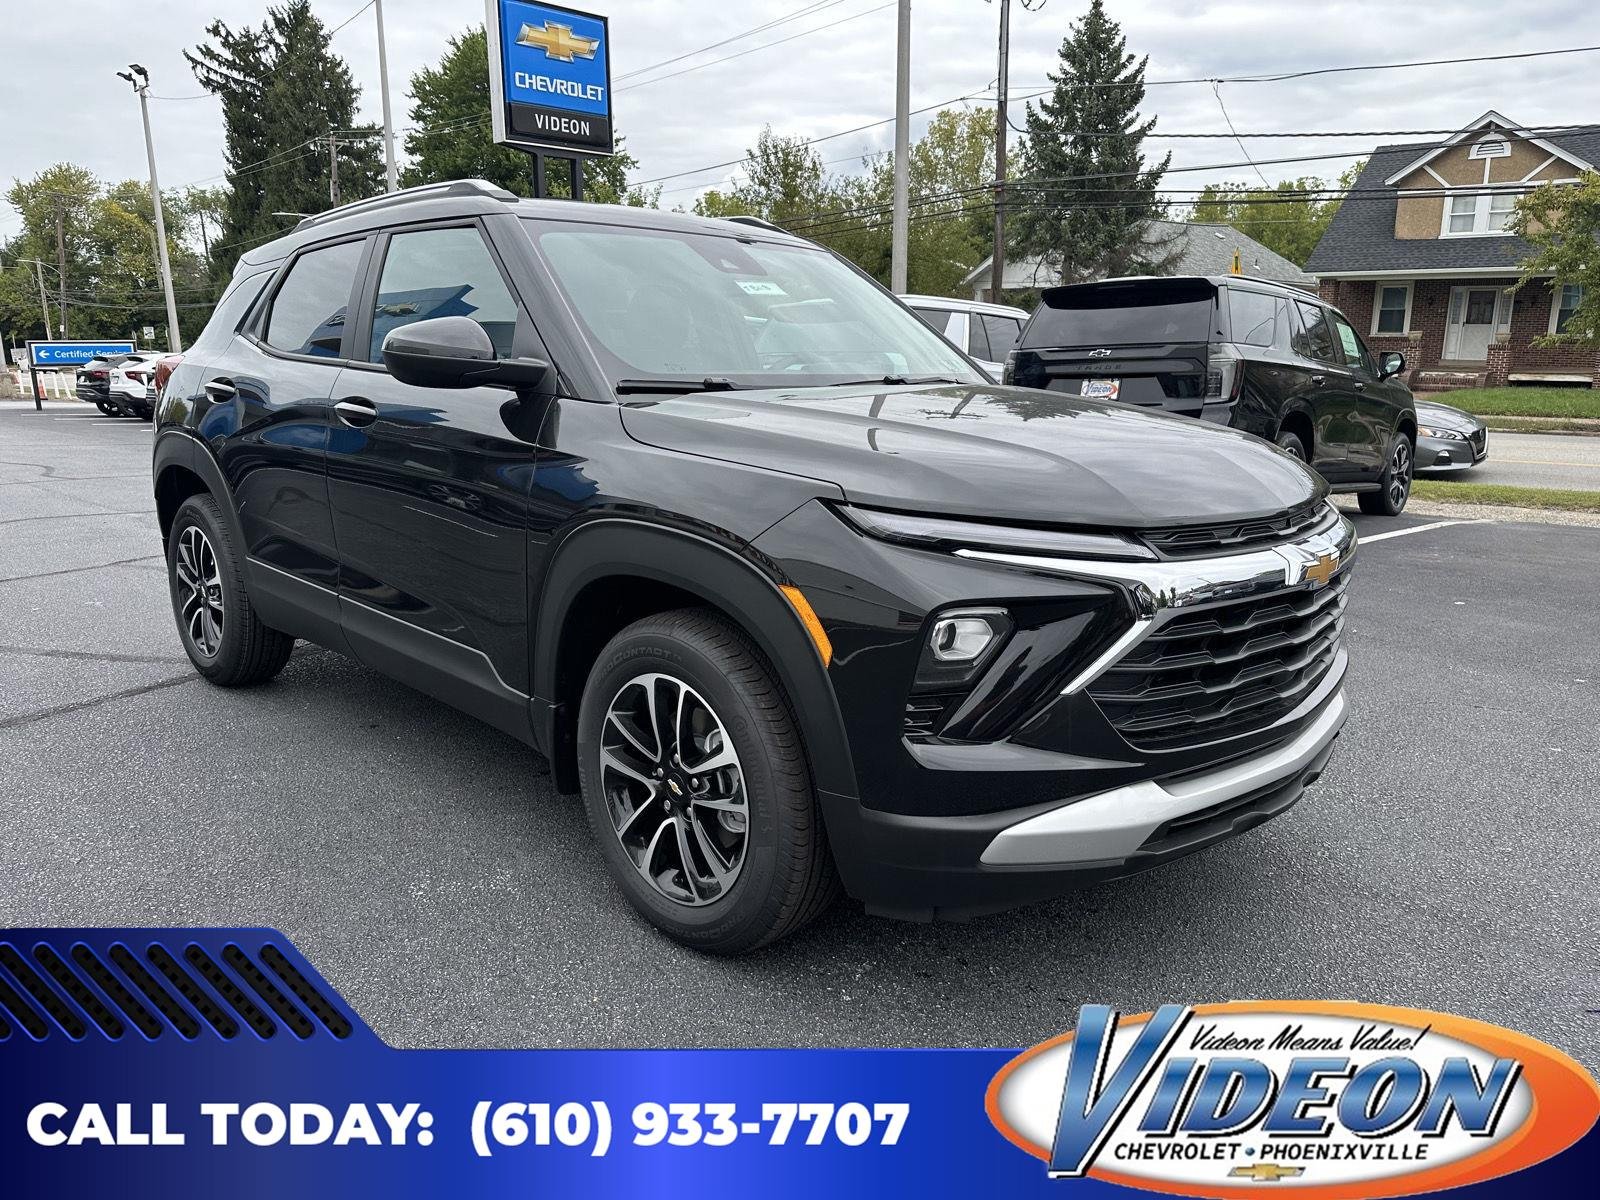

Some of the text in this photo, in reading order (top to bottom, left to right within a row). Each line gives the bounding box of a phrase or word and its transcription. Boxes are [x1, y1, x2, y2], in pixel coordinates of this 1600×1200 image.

[514, 71, 605, 101] CHEVROLET
[534, 113, 591, 136] VIDEON
[54, 350, 94, 359] Certified
